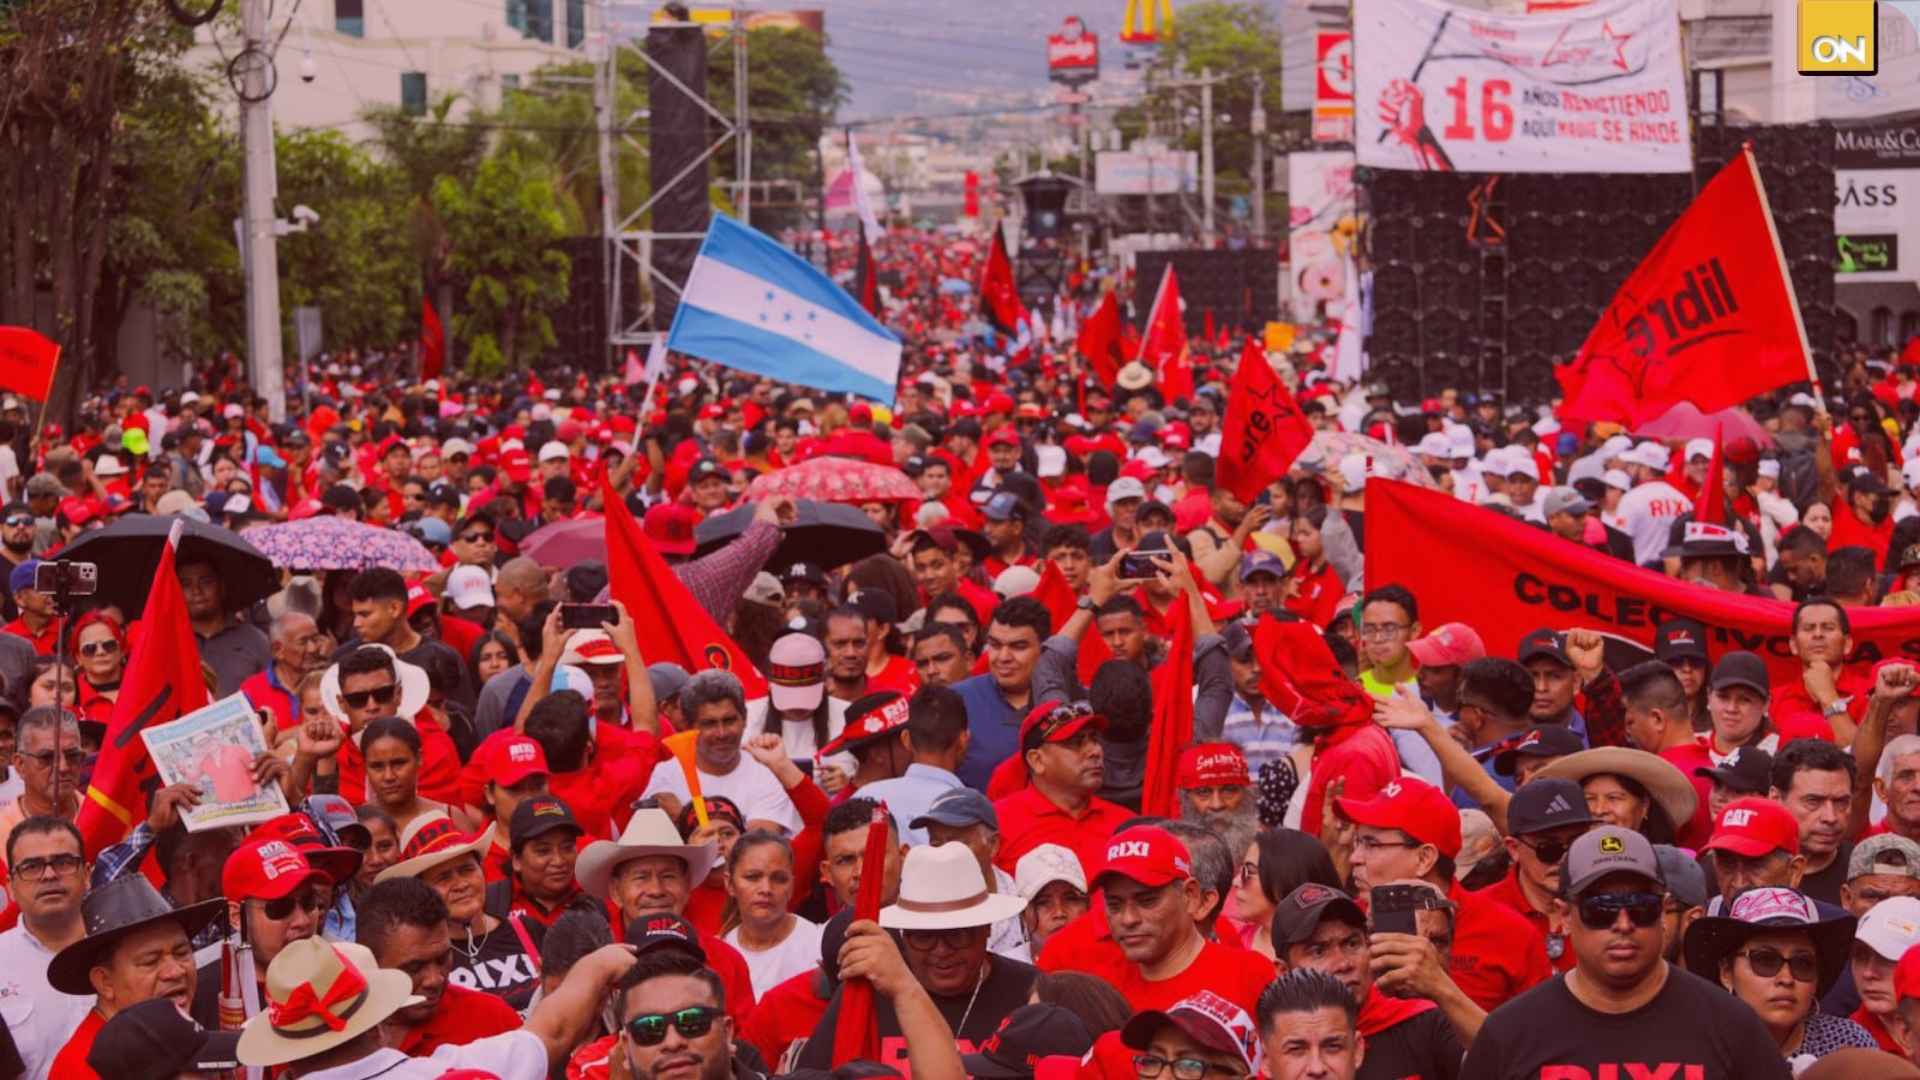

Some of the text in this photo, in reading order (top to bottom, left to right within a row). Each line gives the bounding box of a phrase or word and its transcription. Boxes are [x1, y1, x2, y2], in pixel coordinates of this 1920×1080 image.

[1443, 76, 1515, 142] 16
[1602, 120, 1625, 143] SE
[1108, 840, 1150, 862] RIXI
